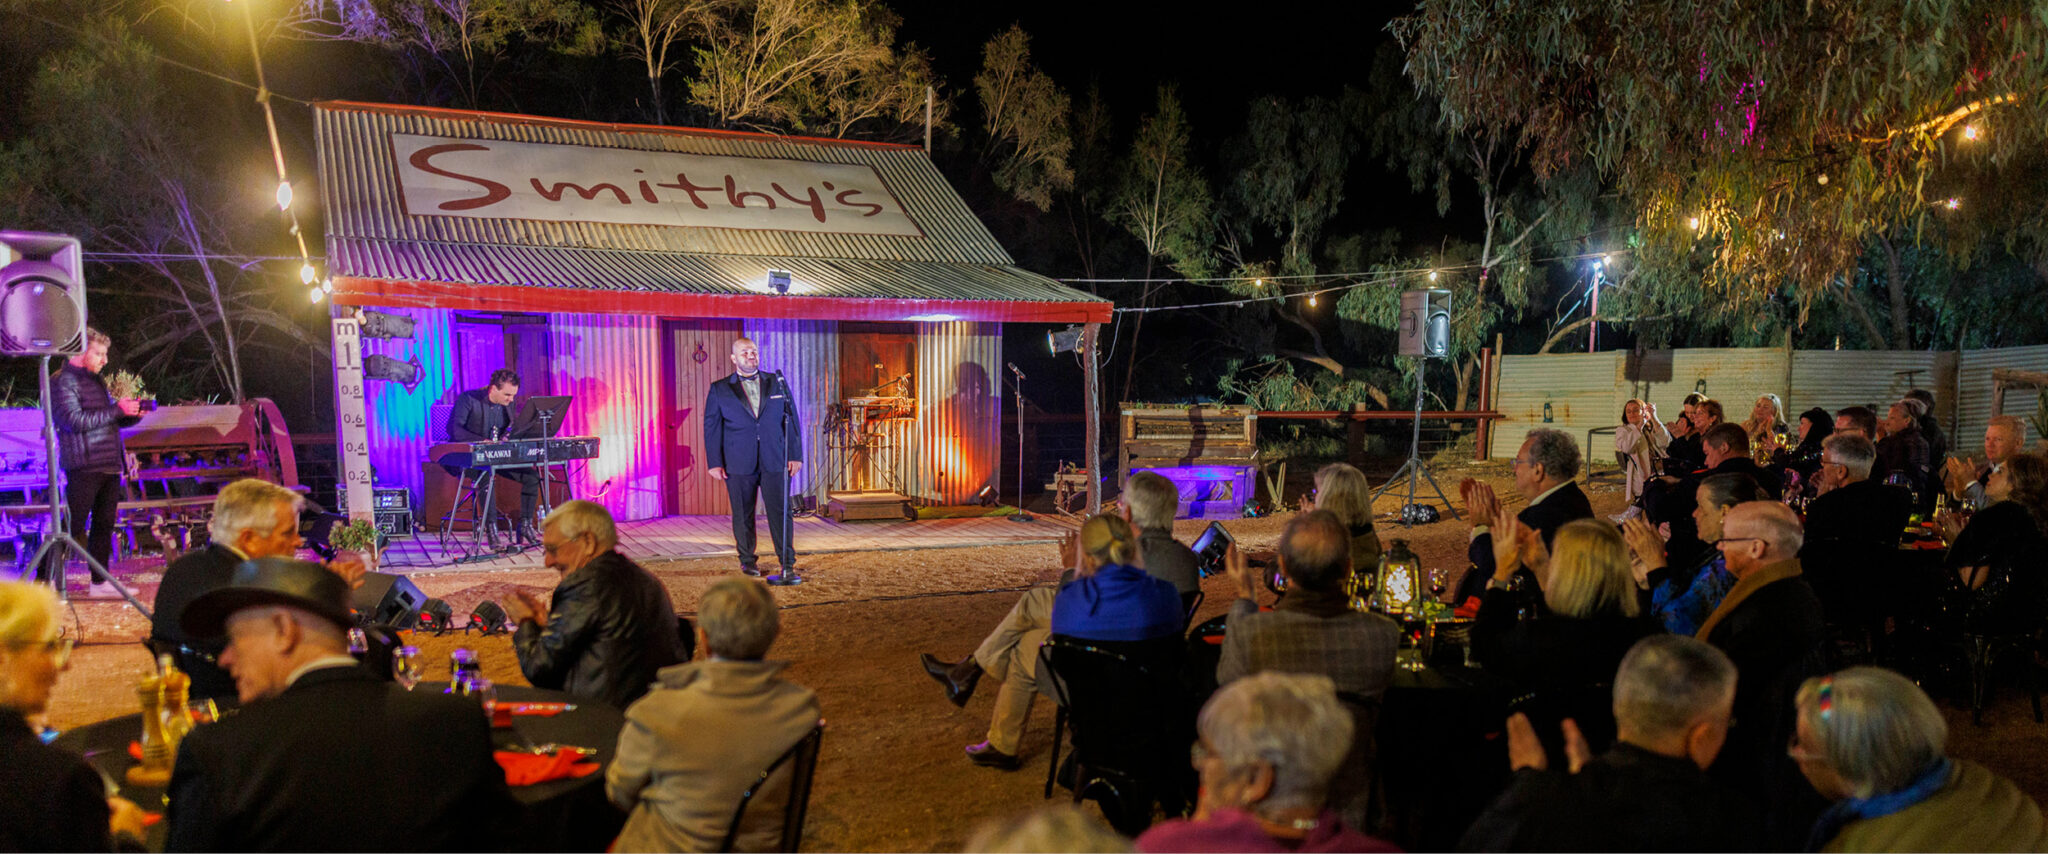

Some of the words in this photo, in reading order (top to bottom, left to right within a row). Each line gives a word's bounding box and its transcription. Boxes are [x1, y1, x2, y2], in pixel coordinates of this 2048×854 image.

[410, 144, 883, 224] Smithy's
[336, 322, 356, 335] m
[344, 342, 351, 366] 1
[341, 385, 361, 395] 0.8
[343, 414, 363, 424] 0.6
[345, 442, 365, 452] 0.4
[487, 449, 512, 459] KAWAI
[348, 470, 367, 480] 0.2
